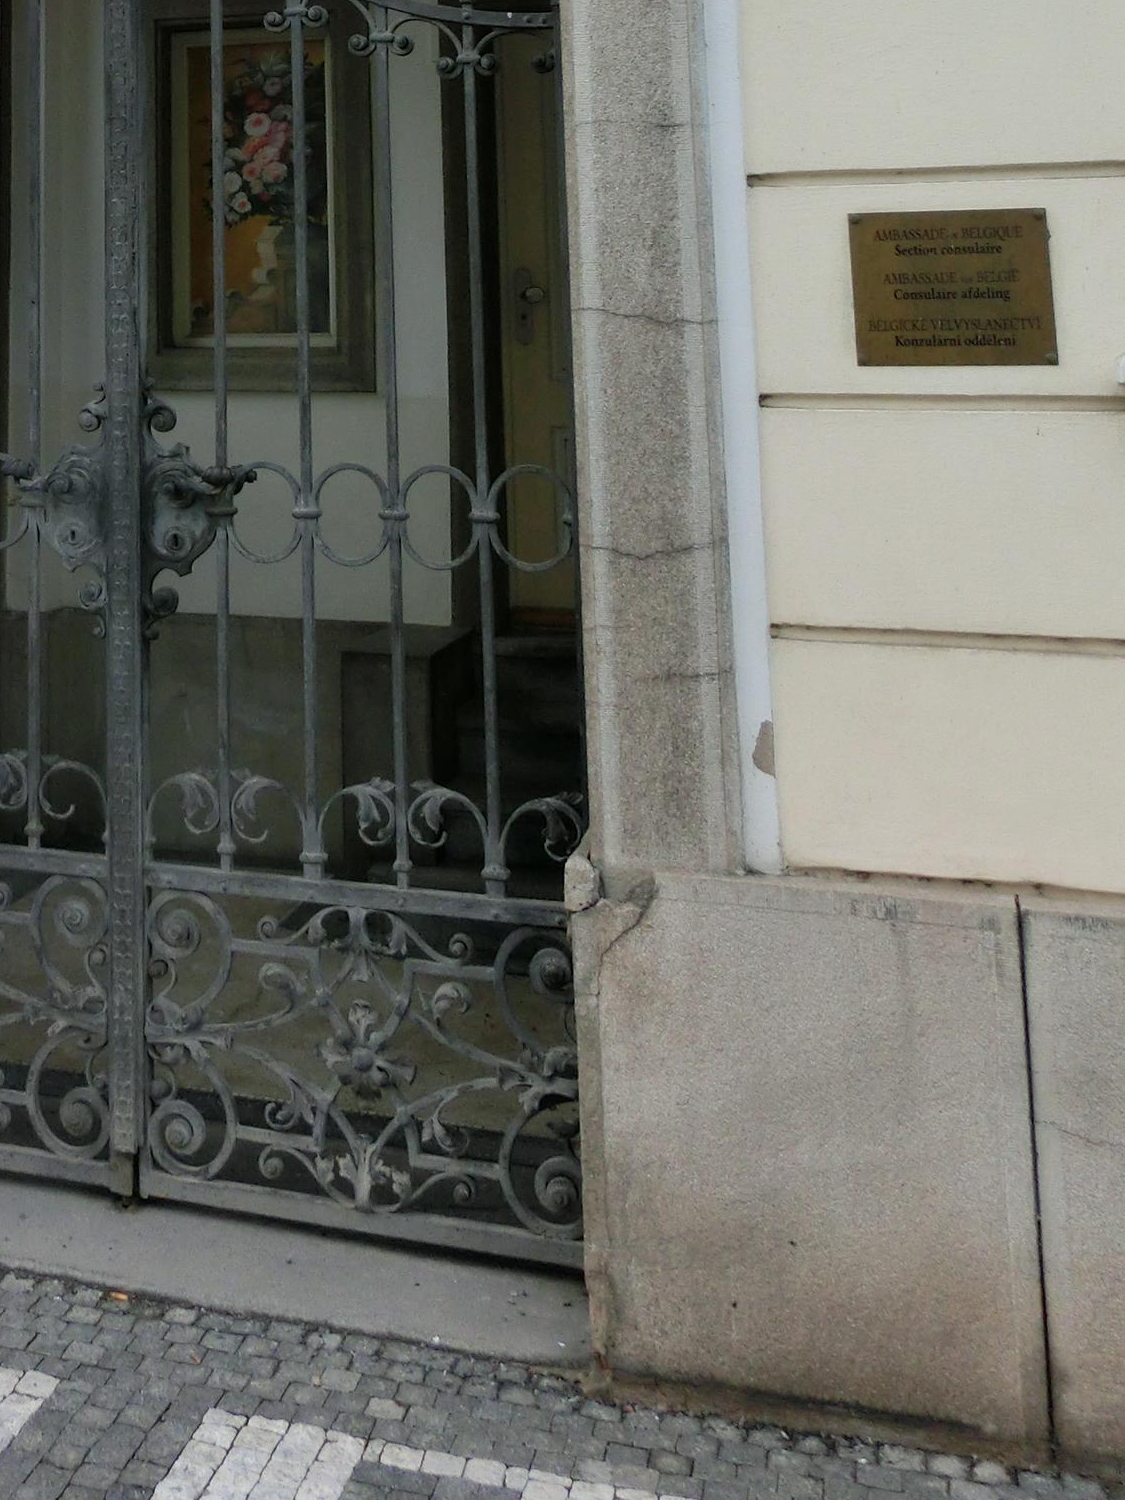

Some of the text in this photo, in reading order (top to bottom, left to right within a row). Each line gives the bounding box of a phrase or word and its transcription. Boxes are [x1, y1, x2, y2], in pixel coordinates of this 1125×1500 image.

[874, 227, 948, 241] AMBASSADE
[961, 225, 1024, 241] BELGIQUE
[894, 242, 1002, 256] Section consulaire
[883, 271, 957, 284] AMBASSADE
[893, 287, 1011, 302] Consulaire afdeling
